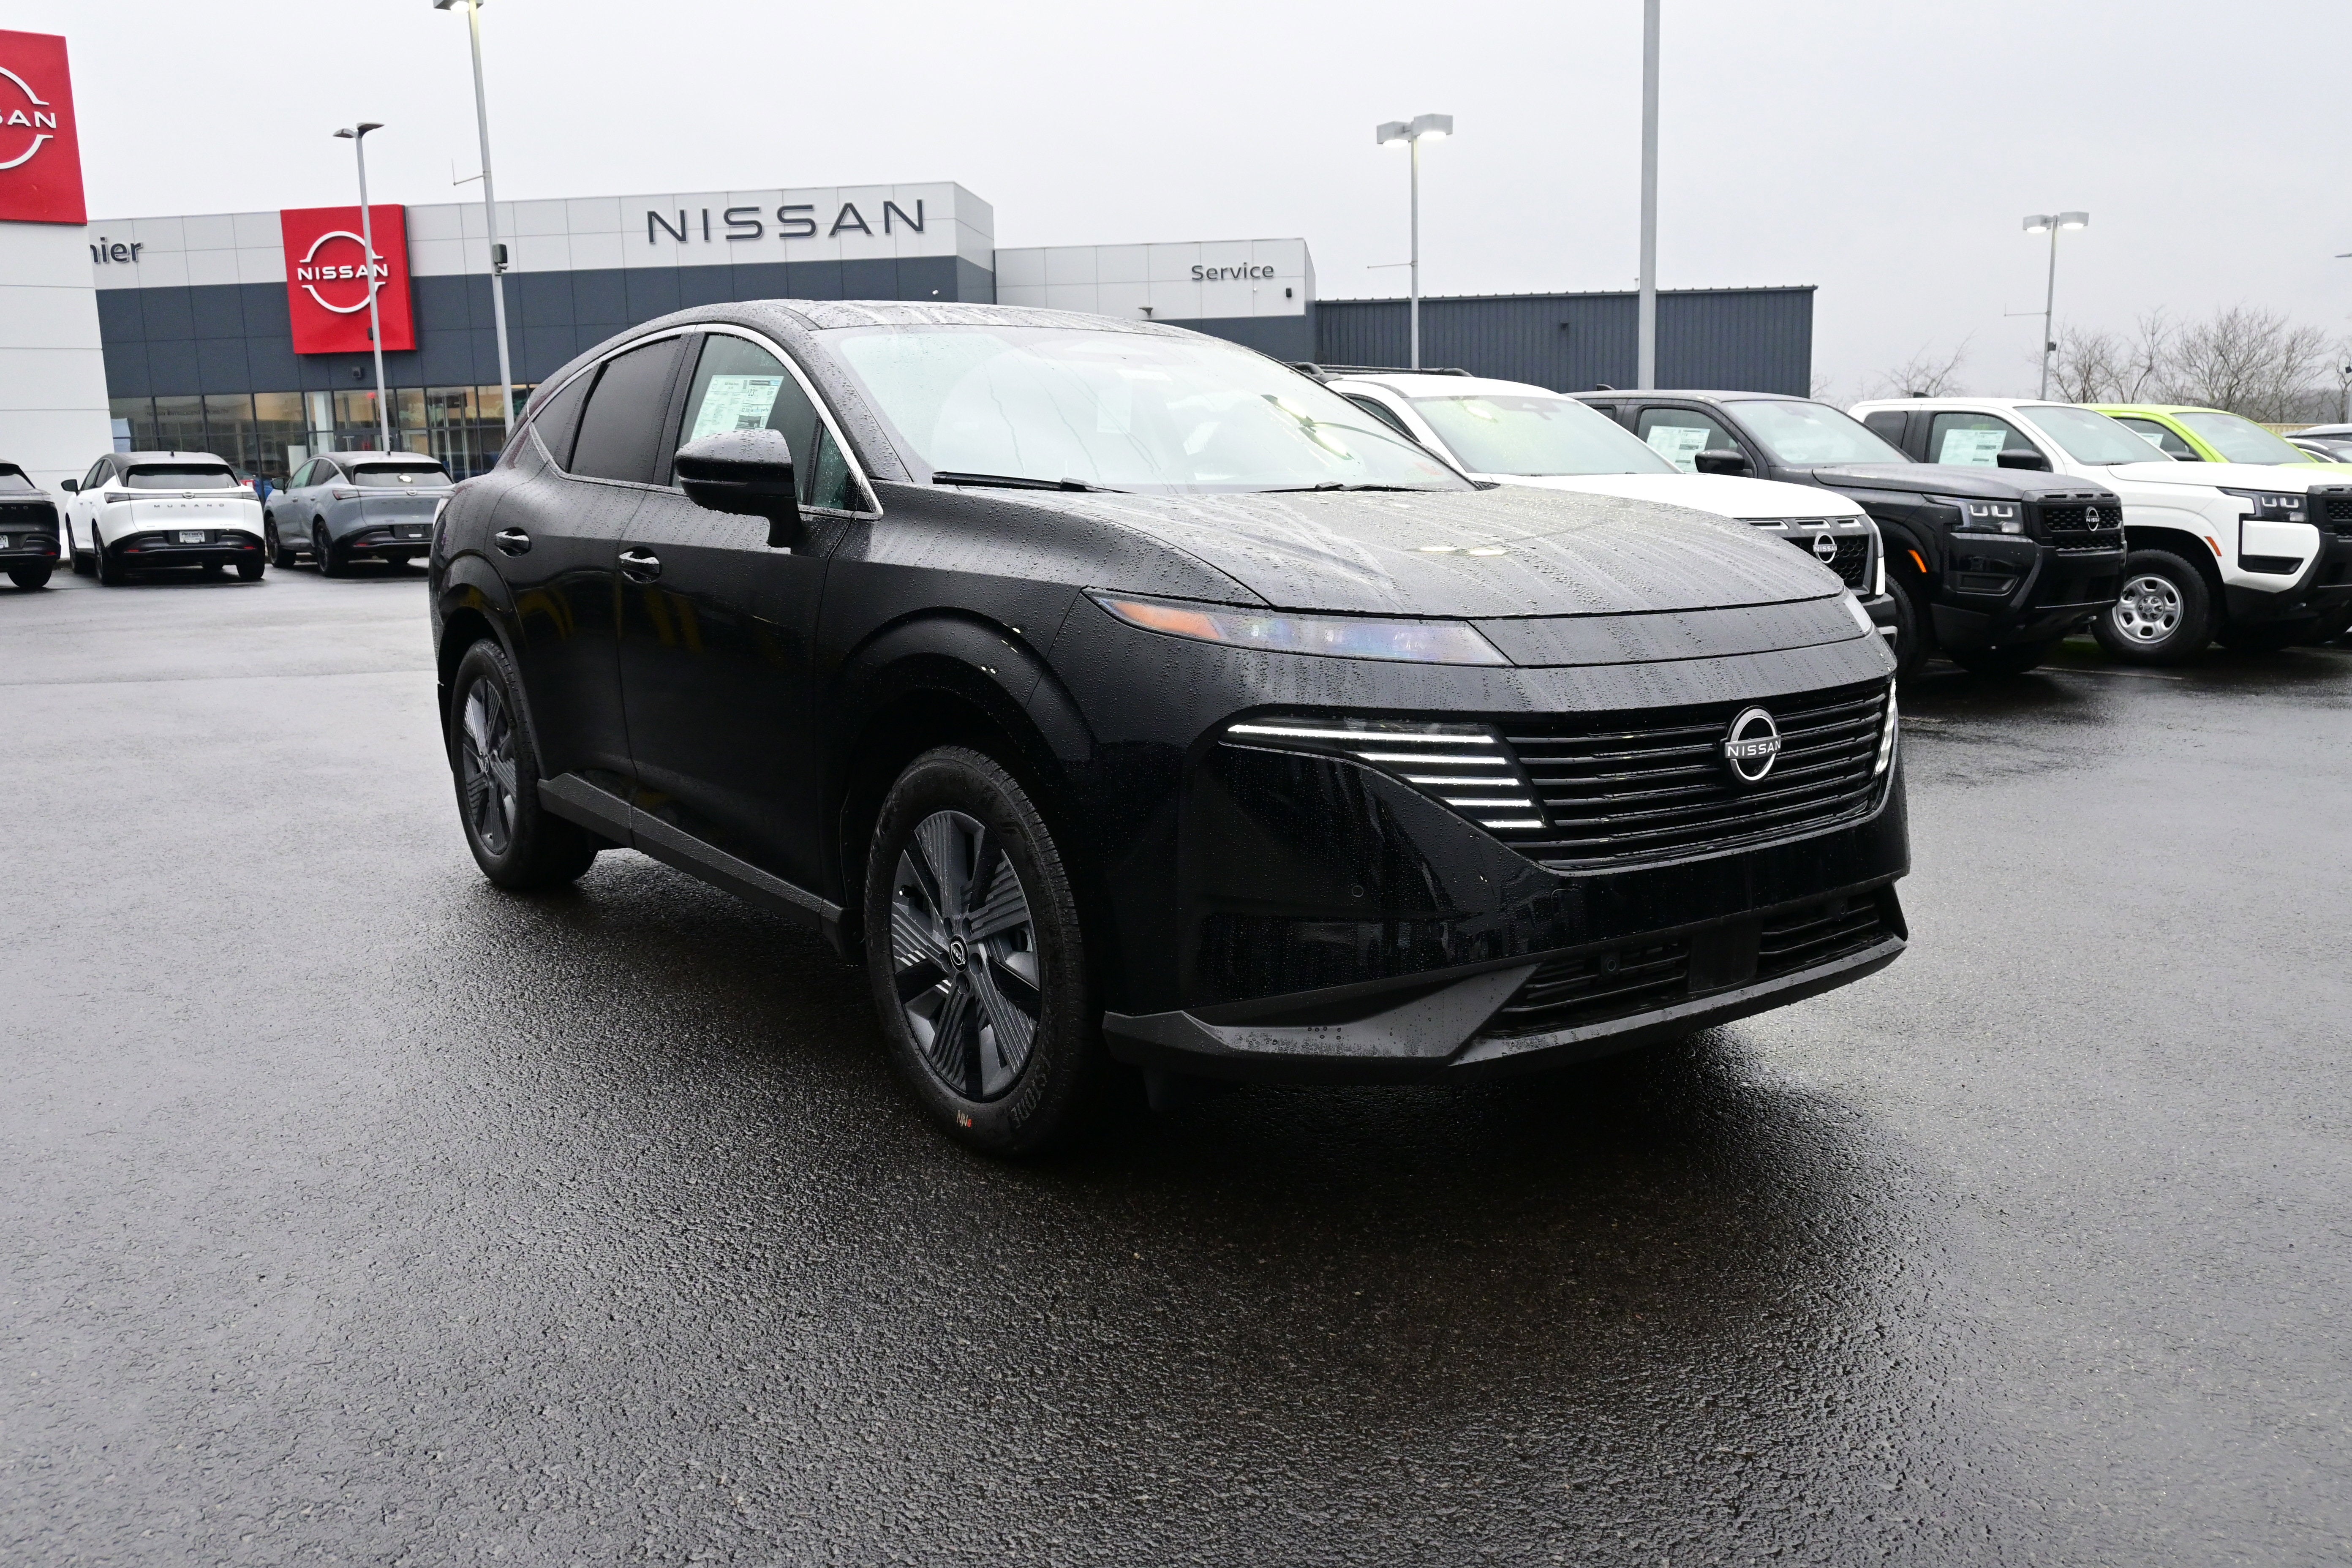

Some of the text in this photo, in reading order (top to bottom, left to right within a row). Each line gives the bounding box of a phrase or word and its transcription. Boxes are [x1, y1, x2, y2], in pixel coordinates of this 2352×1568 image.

[647, 199, 924, 244] NISSAN
[297, 264, 388, 281] NISSAN
[1191, 261, 1274, 281] Service
[1727, 740, 1781, 757] NISSAN
